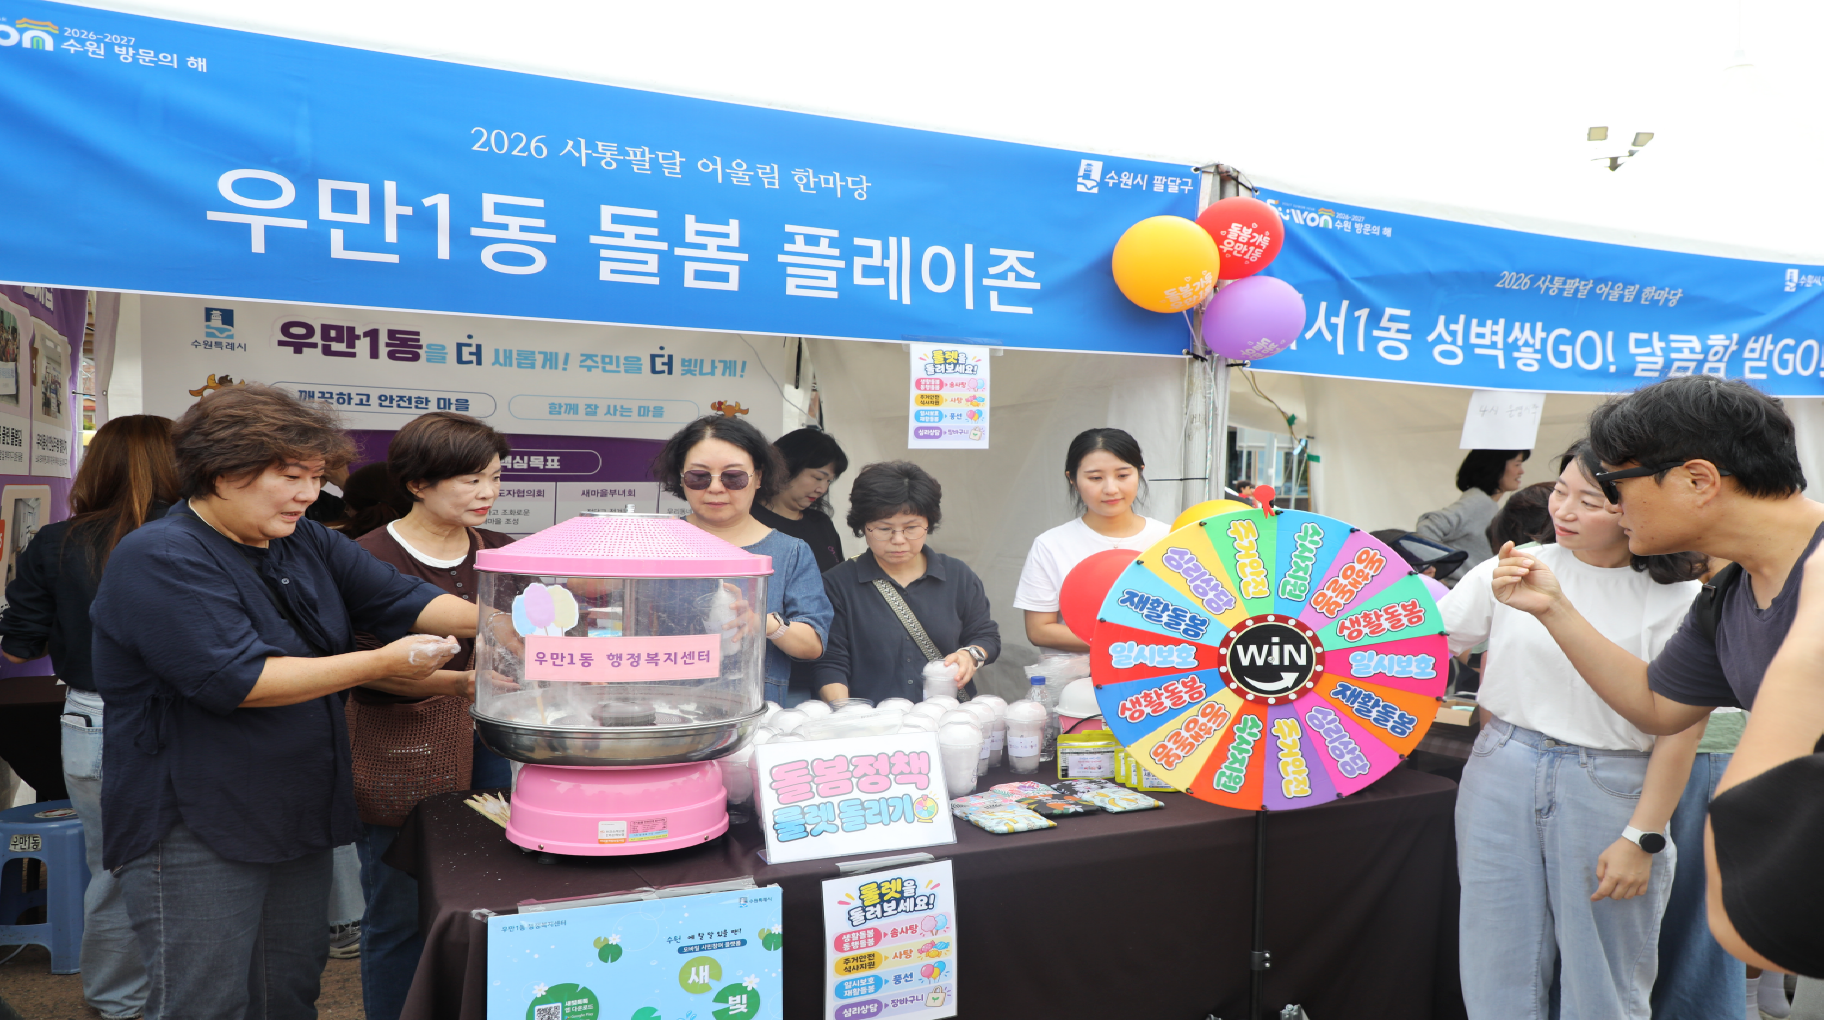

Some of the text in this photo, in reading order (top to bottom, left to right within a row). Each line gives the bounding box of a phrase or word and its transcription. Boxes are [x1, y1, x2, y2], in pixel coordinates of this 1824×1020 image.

[63, 27, 136, 46] 2026-2027
[61, 38, 207, 72] 수원 방문의 해
[470, 127, 872, 201] 2026 사통팔달 어울림 한마당
[1104, 170, 1194, 194] 수원시 팔달구
[206, 168, 1041, 314] 우만1동 돌봄 플레이존
[1226, 222, 1271, 250] 돌봄 가득
[1335, 219, 1393, 237] 수원 방문의 해
[1219, 239, 1264, 262] 우만1동
[1495, 271, 1684, 307] 2026 사통팔달 어울림 한마당
[190, 339, 247, 352] 수원특례시
[277, 320, 449, 364] 우만1동을
[491, 347, 570, 372] 새롭게!
[578, 352, 644, 375] 주민을
[680, 357, 747, 379] 빛나게!
[1291, 294, 1412, 362] 서1동
[1426, 312, 1616, 373] 성벽쌓GO!
[1628, 330, 1741, 380] 달콤함
[298, 389, 470, 412] 깨끗하고 안전한 마을
[548, 402, 665, 419] 함께 잘 사는 마을
[581, 488, 636, 498] 새마을부녀회
[1227, 519, 1271, 600] 주거안전
[1277, 522, 1325, 602] 식사지원
[1162, 546, 1237, 615] 심리상담
[1310, 547, 1387, 619] 동행돌봄
[1118, 588, 1210, 640] 재활돌봄
[1336, 598, 1426, 643] 생활돌봄
[534, 649, 711, 668] 우만1동 행정복지센터
[1108, 641, 1200, 669] 일시보호
[1348, 650, 1437, 680] 일시보호
[1118, 674, 1207, 723] 생활돌봄
[1330, 681, 1418, 738] 재활돌봄
[1149, 700, 1231, 771] 동행돌봄
[1305, 705, 1371, 779] 심리상담
[1213, 714, 1263, 794] 식사지원
[1270, 717, 1312, 799] 주거안전
[769, 750, 931, 805] 돌봄정책
[838, 793, 915, 833] 돌리기
[11, 835, 41, 850] 우만1동
[859, 877, 917, 907] 룰렛을
[848, 893, 936, 927] 돌려보세요!
[666, 935, 682, 944] 수원
[841, 927, 875, 943] 생활돌봄
[841, 938, 875, 951] 동행돌봄
[890, 924, 919, 938] 솜사탕
[843, 953, 876, 966] 주거안전
[843, 961, 876, 973] 식사지원
[891, 949, 914, 960] 사탕
[687, 964, 710, 985] 새
[843, 977, 876, 990] 일시보호
[892, 972, 914, 985] 풍선
[728, 994, 748, 1015] 빛
[843, 985, 876, 997] 재활돌봄
[890, 994, 924, 1008] 장바구니
[842, 1003, 879, 1018] 심리상담
